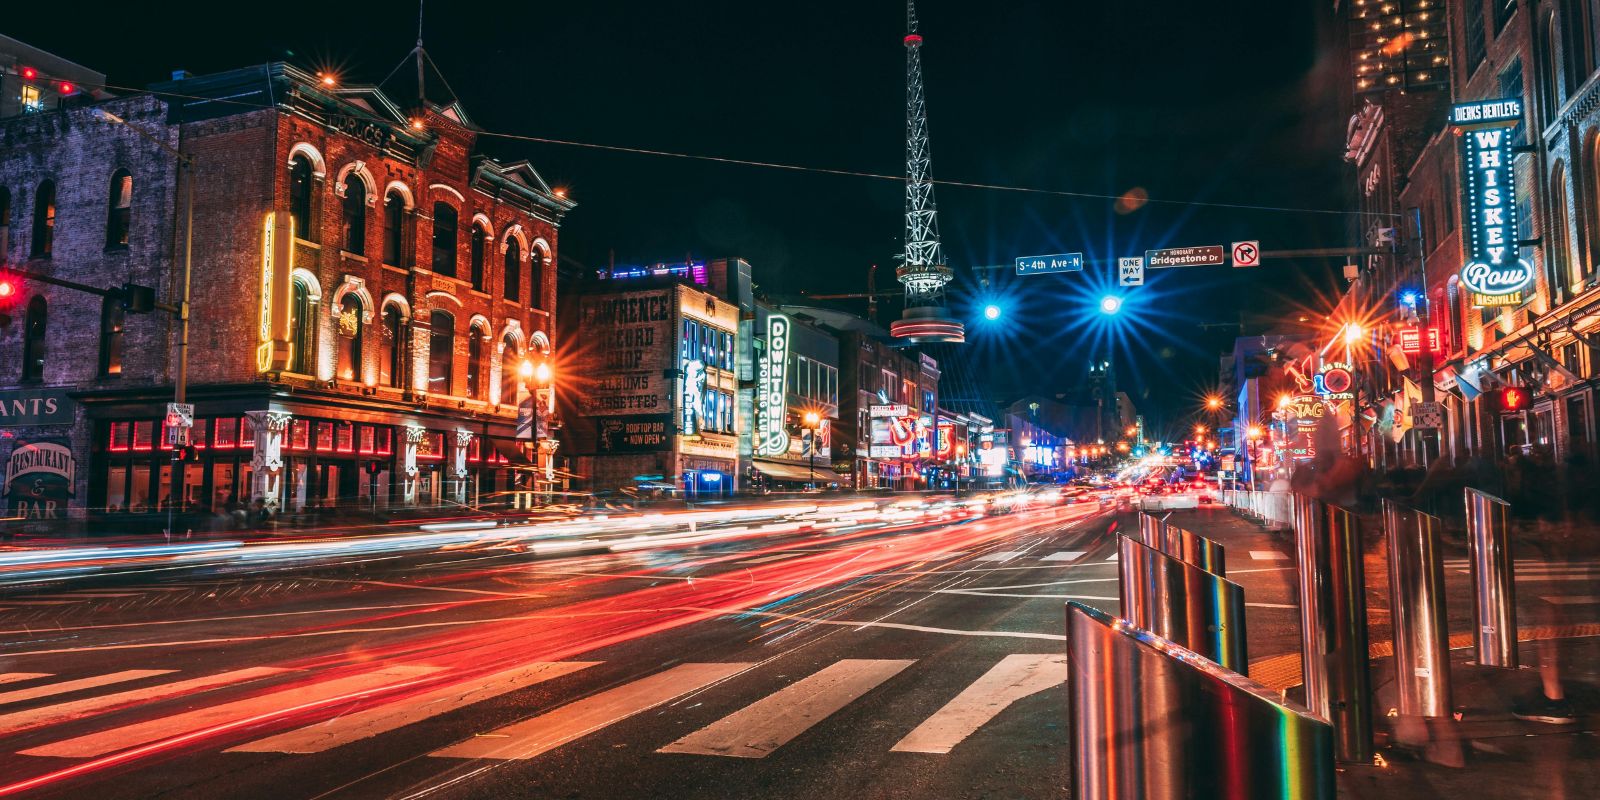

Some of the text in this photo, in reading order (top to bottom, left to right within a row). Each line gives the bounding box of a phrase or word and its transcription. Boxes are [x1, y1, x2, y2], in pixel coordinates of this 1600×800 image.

[1455, 105, 1481, 122] DIERKS
[1475, 130, 1503, 265] WHISKEY
[1123, 258, 1140, 267] ONE
[1150, 253, 1207, 265] Bridgestone
[1123, 266, 1140, 275] WAY
[1470, 263, 1525, 293] Row
[1475, 292, 1522, 306] NASHVILLE
[598, 328, 654, 350] RECORD
[606, 350, 644, 370] SHOP
[1319, 362, 1354, 373] BIG TIME
[599, 376, 649, 391] ALBUMS
[759, 357, 768, 408] SPORTING
[770, 322, 785, 433] DOWNTOWN
[590, 394, 658, 411] CASSETTES
[625, 423, 652, 435] ROOFTOP
[652, 422, 664, 433] BAR
[758, 411, 767, 438] CLUB
[1414, 415, 1425, 426] OK
[630, 433, 660, 445] NOW OPEN
[11, 448, 69, 477] RESTAURANT
[31, 479, 45, 496] &
[17, 500, 58, 520] BAR
